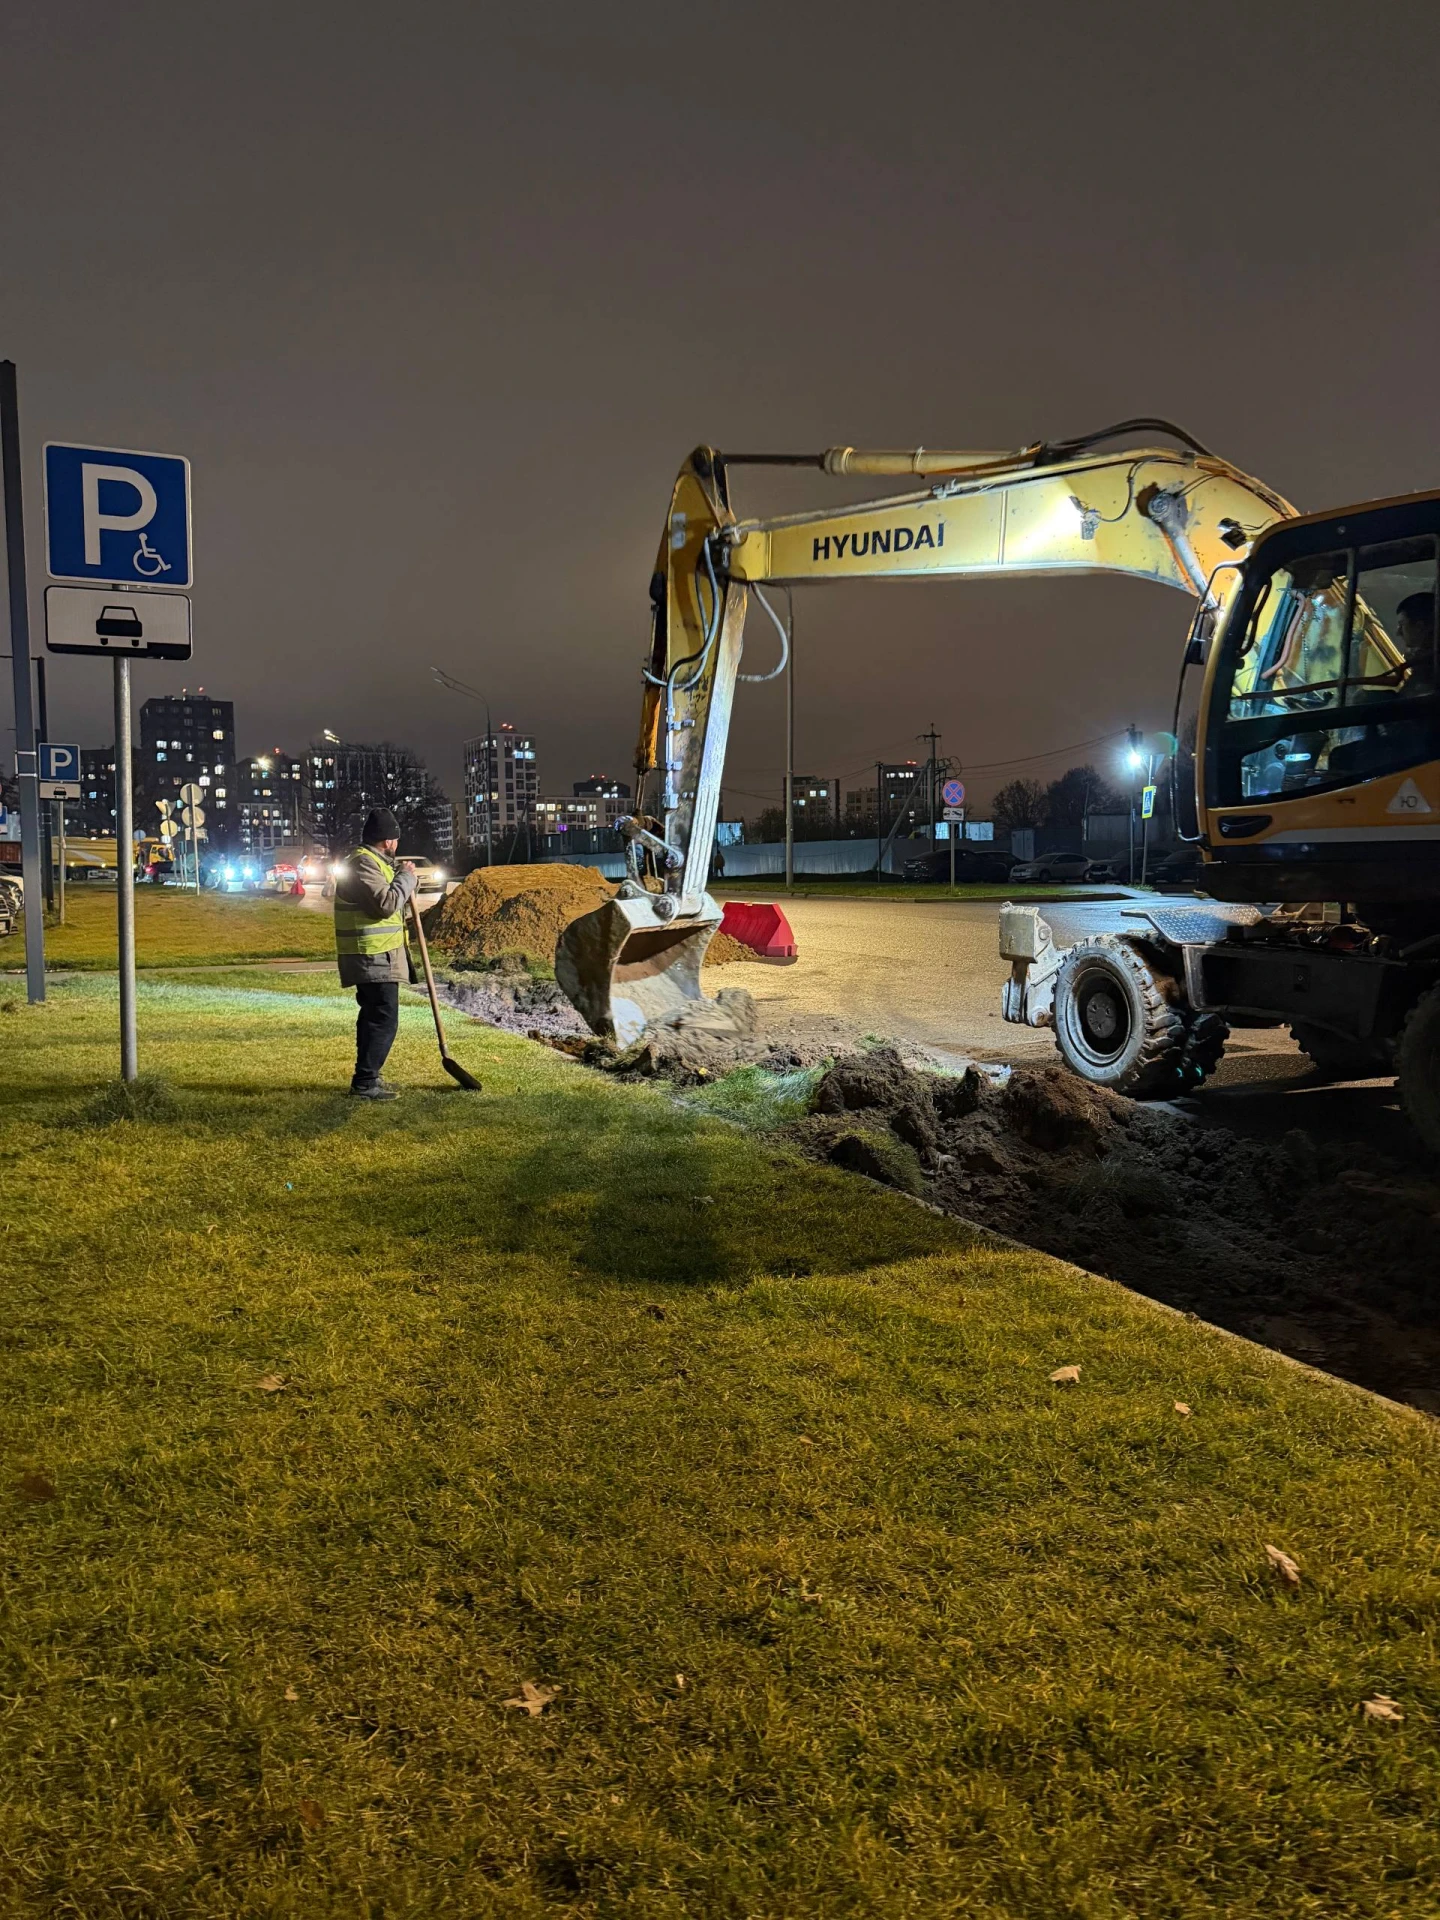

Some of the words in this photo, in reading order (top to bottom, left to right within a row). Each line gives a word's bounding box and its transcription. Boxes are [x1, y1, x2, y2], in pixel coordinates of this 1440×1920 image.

[82, 462, 157, 565] P
[813, 523, 944, 561] HYUNDAI
[50, 748, 72, 777] P
